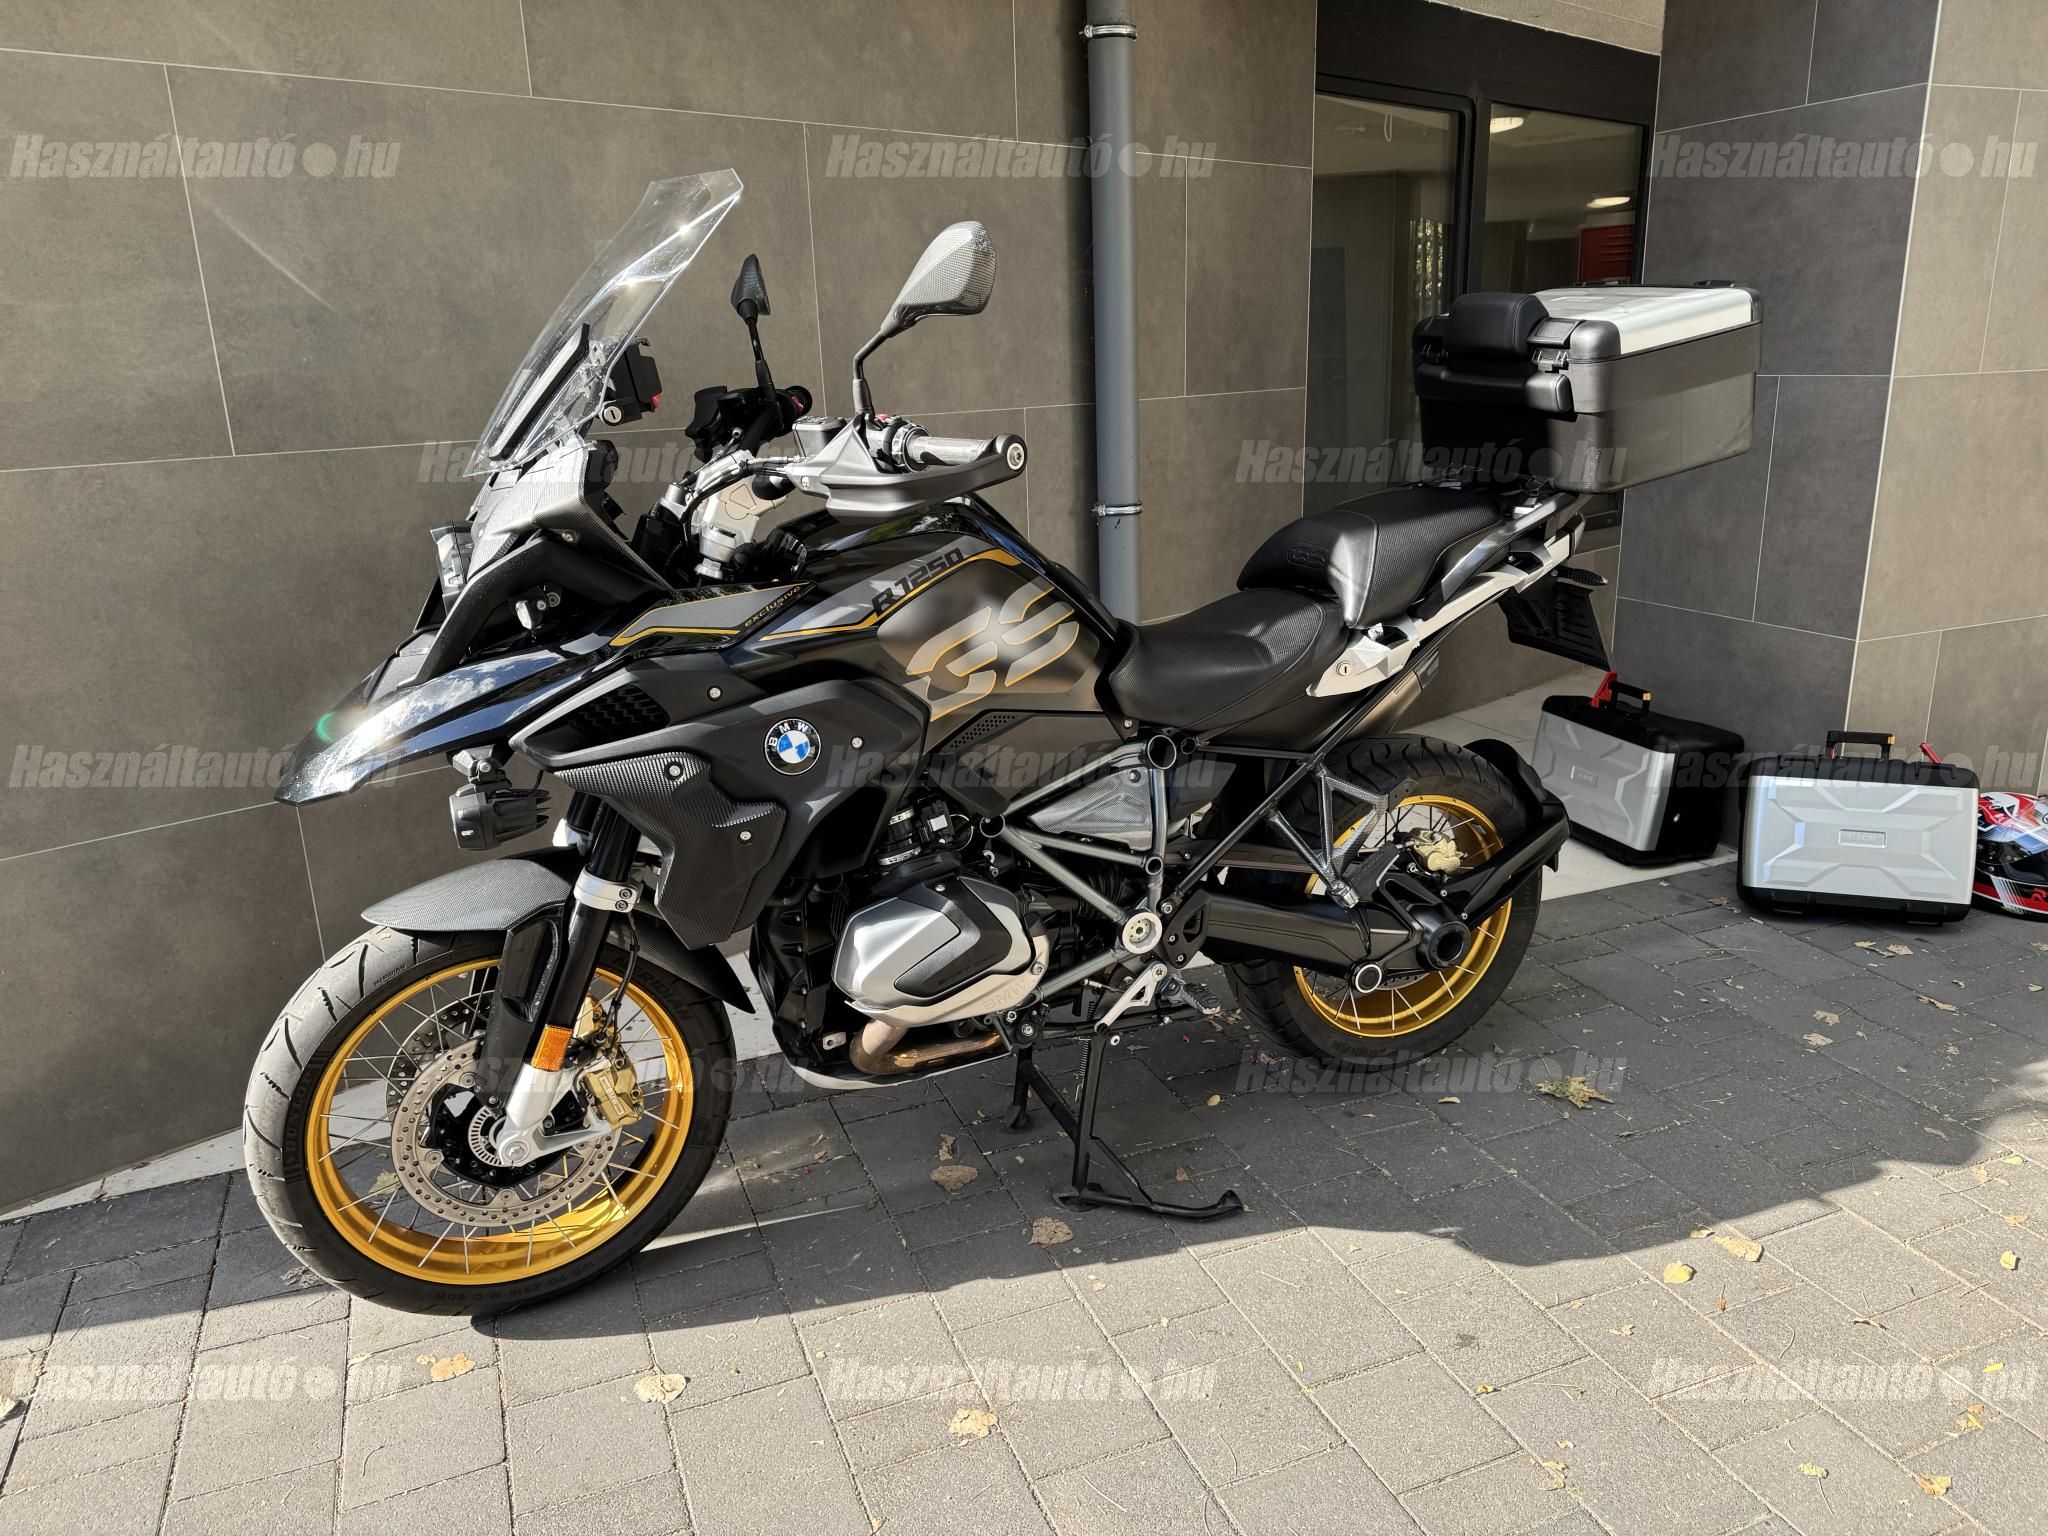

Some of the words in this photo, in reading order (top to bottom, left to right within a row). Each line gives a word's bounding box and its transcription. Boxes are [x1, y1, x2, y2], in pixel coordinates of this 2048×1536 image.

[744, 585, 801, 627] exclusive
[903, 575, 1080, 722] GS
[768, 722, 809, 747] BMW
[982, 978, 1028, 1010] BMW
